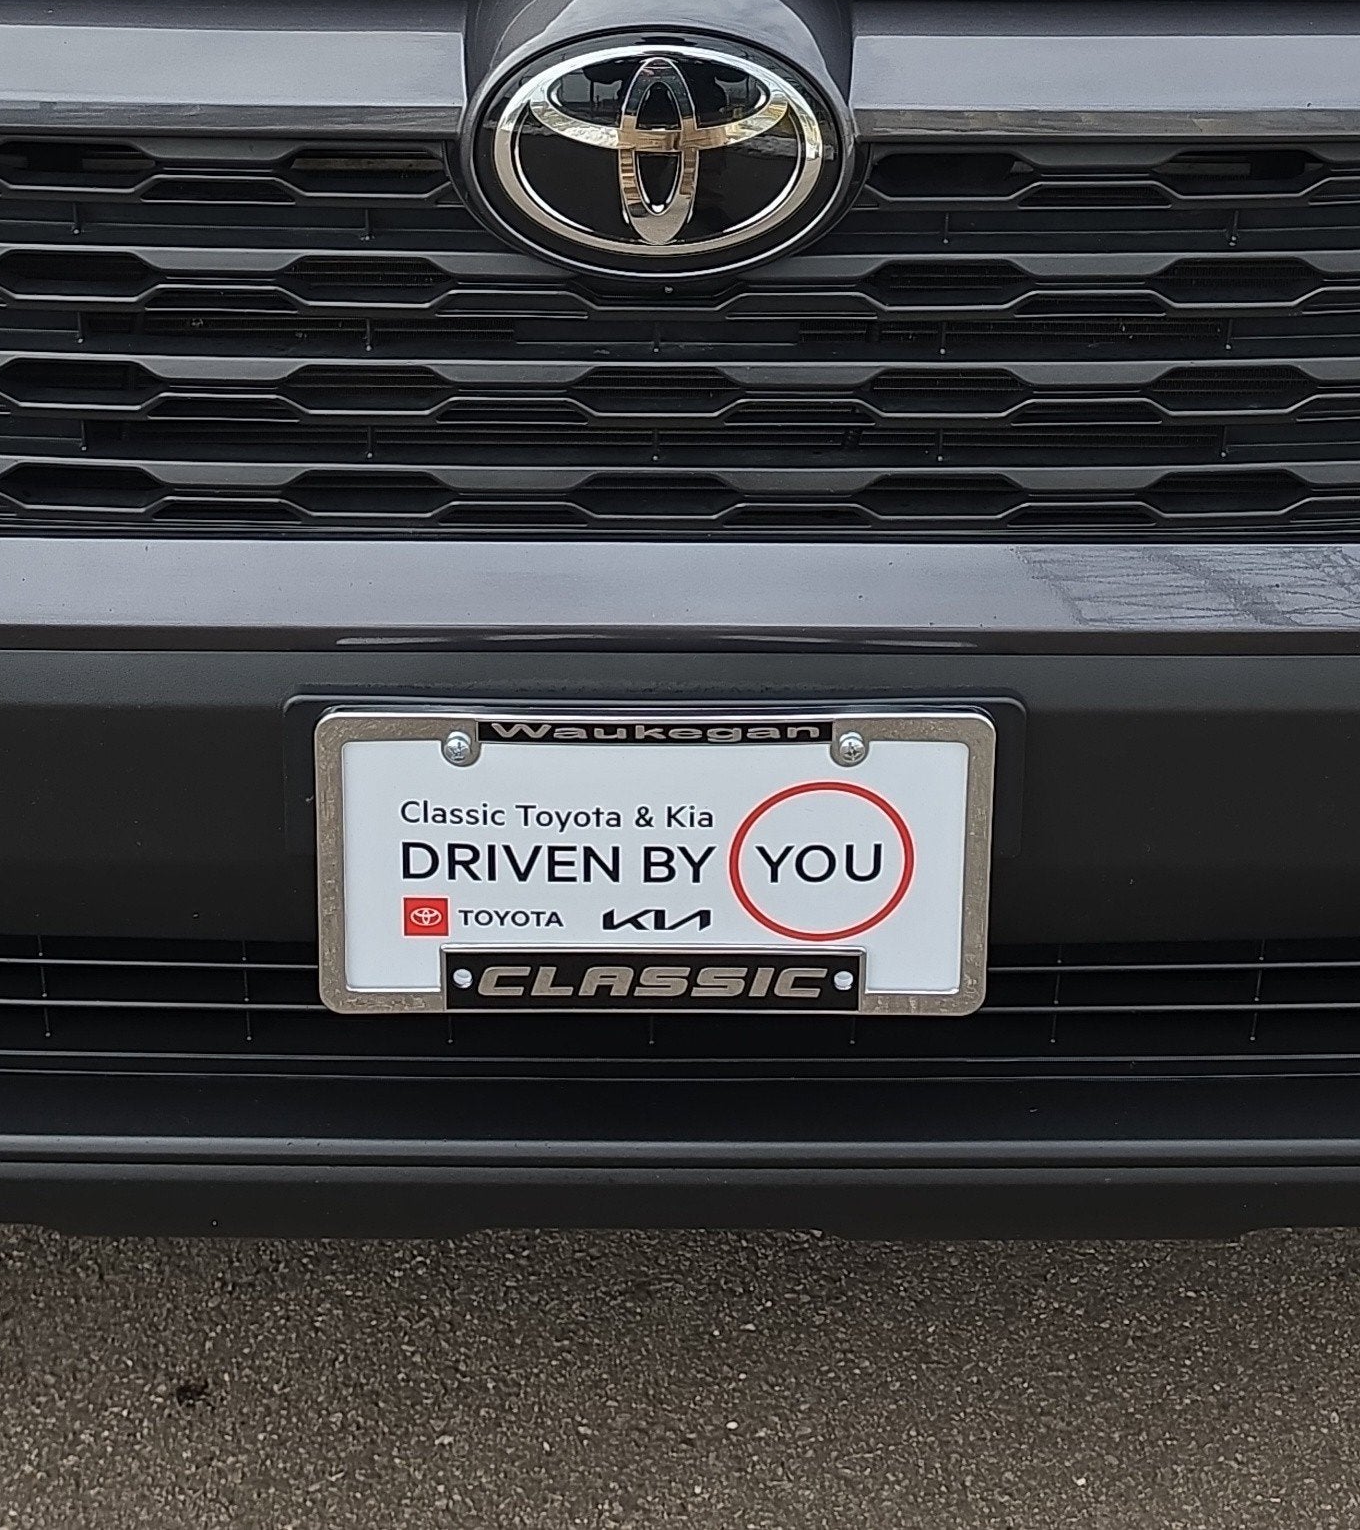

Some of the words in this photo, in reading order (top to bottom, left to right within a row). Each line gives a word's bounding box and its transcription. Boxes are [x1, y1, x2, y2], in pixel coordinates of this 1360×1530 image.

[490, 722, 820, 743] Waukegan
[400, 800, 505, 826] Classic
[515, 804, 621, 832] Toyota
[635, 806, 654, 827] &
[666, 805, 713, 827] Kia
[401, 841, 620, 882] DRIVEN
[642, 846, 717, 883] BY
[756, 843, 884, 882] YOU
[458, 909, 564, 927] TOYOTA
[477, 966, 828, 998] CLASSIC
